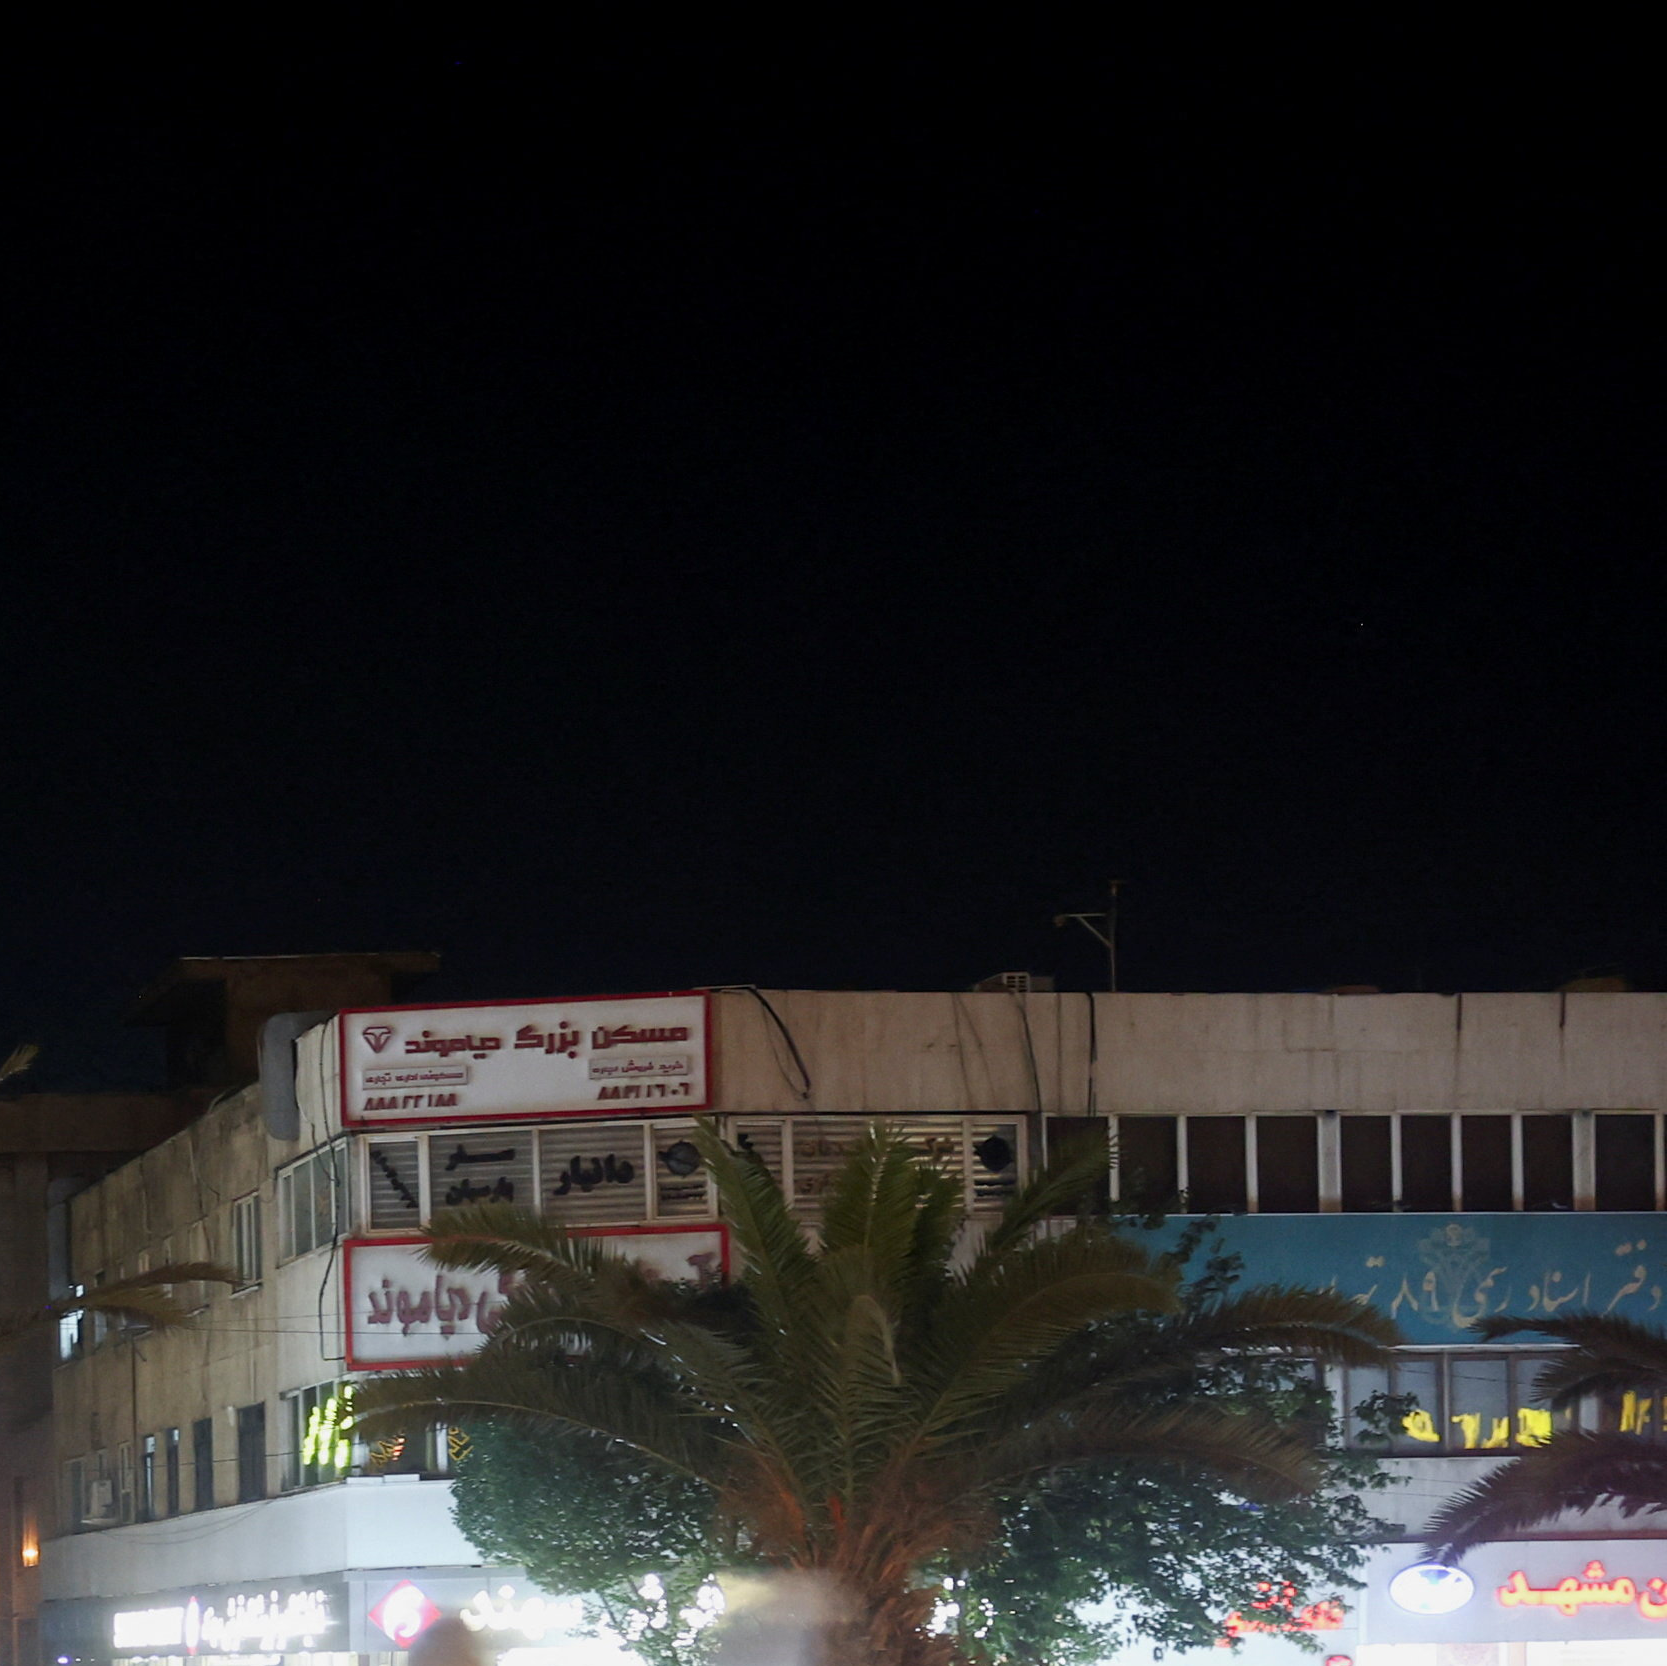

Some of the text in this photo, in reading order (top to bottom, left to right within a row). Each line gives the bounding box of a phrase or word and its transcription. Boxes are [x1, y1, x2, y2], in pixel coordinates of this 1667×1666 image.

[404, 1021, 689, 1060] مسکن بزرگ دیاموند
[1451, 1266, 1511, 1329] رسمی
[1526, 1270, 1592, 1314] اسناد
[1601, 1238, 1663, 1317] دفتر
[1498, 1559, 1636, 1617] مشهد
